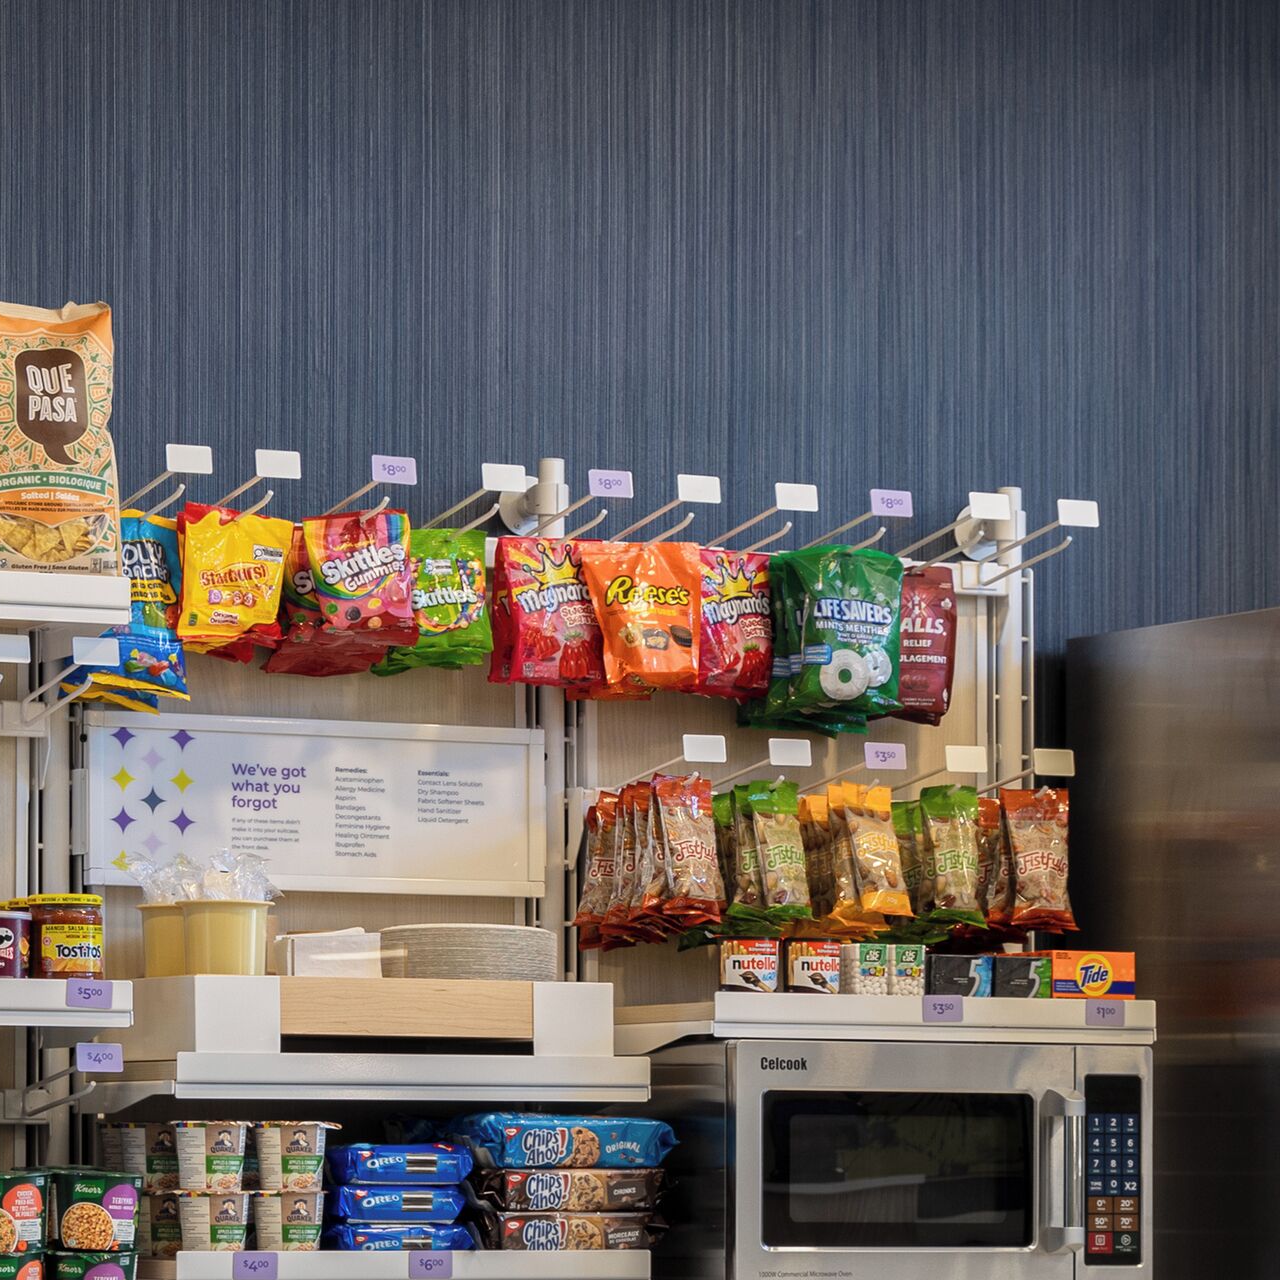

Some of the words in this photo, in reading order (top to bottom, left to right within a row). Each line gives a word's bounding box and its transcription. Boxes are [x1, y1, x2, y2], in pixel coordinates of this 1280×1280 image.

[26, 363, 72, 394] QUE
[29, 396, 78, 423] PASA
[48, 475, 102, 491] BIOLOGIQUE
[322, 544, 406, 585] Skittles
[345, 562, 405, 591] Gummies
[607, 576, 689, 605] Reese's
[816, 621, 844, 632] MINTS
[903, 639, 932, 648] RELIEF
[232, 763, 277, 778] We've
[281, 766, 307, 780] got
[232, 780, 269, 793] what
[273, 783, 301, 796] you
[231, 795, 278, 811] forgot
[335, 804, 366, 812] Bandages
[335, 813, 381, 821] Decongestants
[365, 824, 391, 832] Hygiene
[335, 832, 359, 840] Healing
[335, 841, 365, 849] Ibuprofen
[1079, 965, 1109, 988] Tide
[760, 1057, 807, 1071] Celcook
[522, 1128, 560, 1149] Chips
[210, 1145, 236, 1154] QUAKER
[606, 1142, 641, 1154] ORIGINAL
[366, 1155, 404, 1169] OREO
[613, 1187, 637, 1196] CHUNKS
[608, 1230, 639, 1239] MORCEAUX
